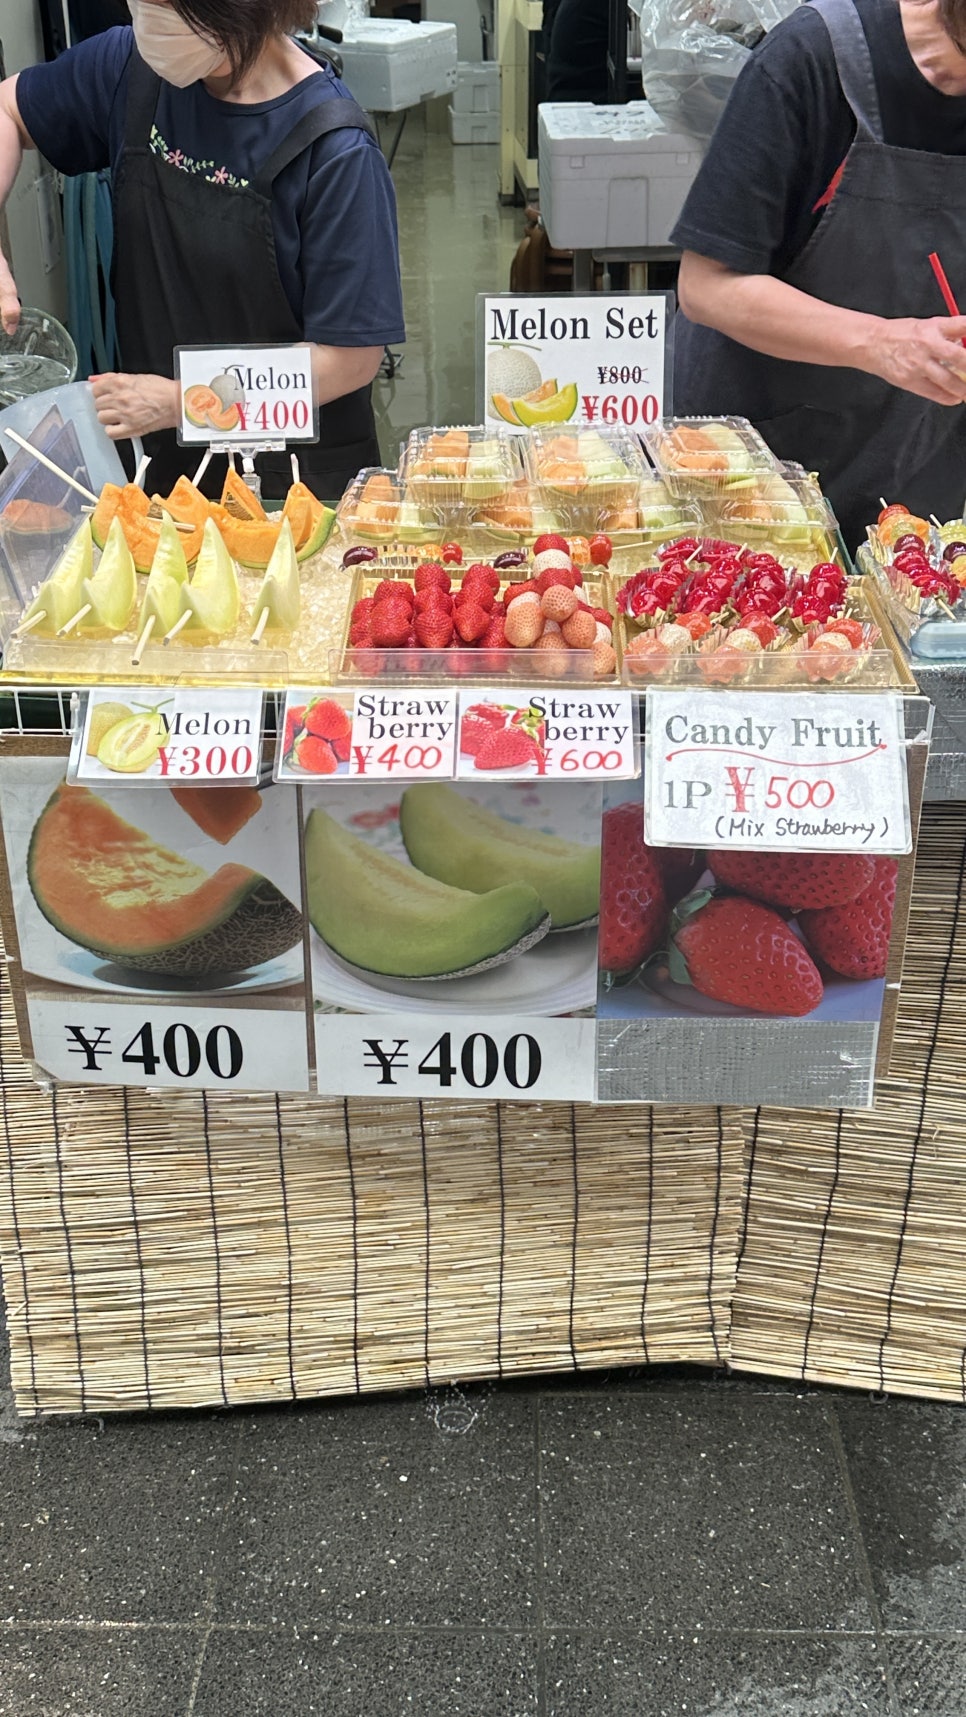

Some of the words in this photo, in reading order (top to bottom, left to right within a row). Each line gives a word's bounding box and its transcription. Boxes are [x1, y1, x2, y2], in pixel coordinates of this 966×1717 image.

[490, 307, 591, 340] Melon
[605, 307, 659, 339] Set
[233, 367, 308, 390] Melon
[597, 365, 643, 385] ¥800
[235, 399, 309, 431] ¥400
[581, 394, 659, 426] ¥600
[357, 694, 450, 717] Straw
[528, 696, 621, 718] Straw
[157, 712, 252, 736] Melon
[369, 717, 453, 741] berry
[545, 719, 629, 744] berry
[665, 714, 777, 750] Candy
[791, 718, 883, 748] Fruit
[156, 745, 253, 776] ¥300
[351, 743, 442, 774] ¥400
[663, 780, 712, 809] 1P
[715, 815, 765, 838] (Mix
[64, 1021, 244, 1079] ¥400
[362, 1031, 542, 1089] ¥400
